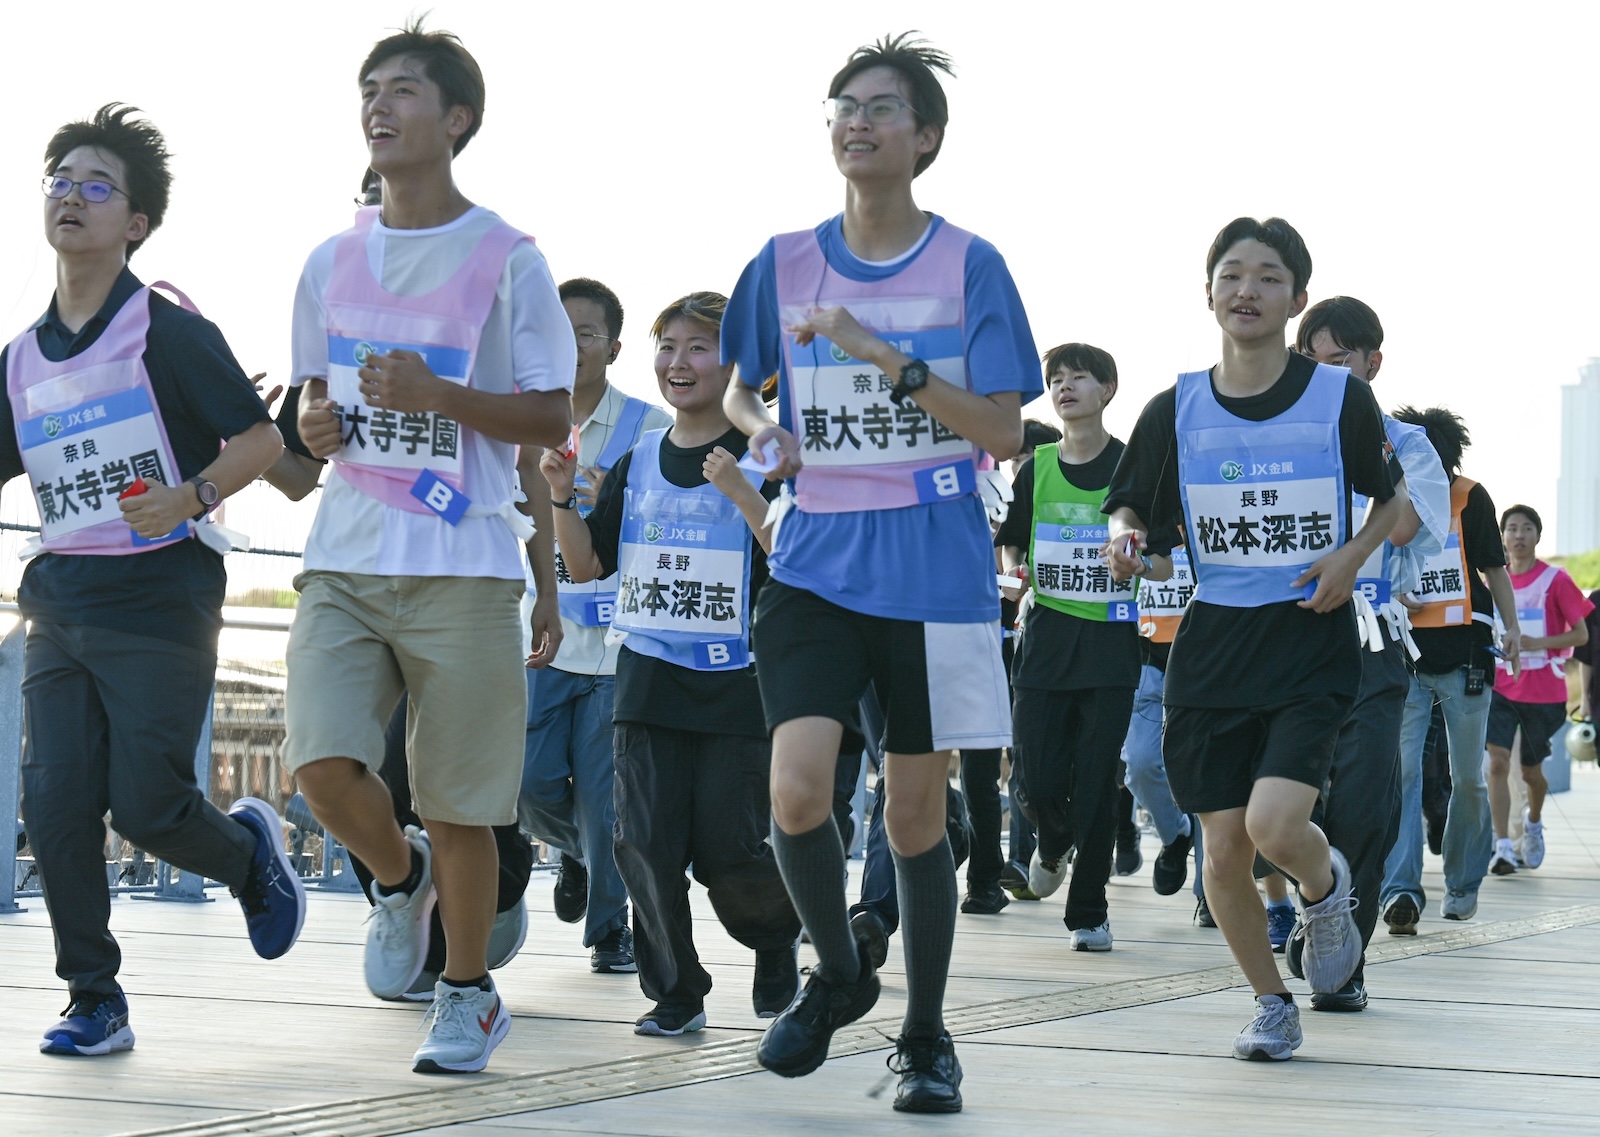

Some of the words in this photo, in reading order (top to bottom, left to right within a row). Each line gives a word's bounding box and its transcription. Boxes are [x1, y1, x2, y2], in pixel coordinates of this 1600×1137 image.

[852, 373, 896, 394] 奈良
[66, 404, 107, 428] JX金属
[62, 437, 100, 464] 奈良
[1248, 461, 1294, 476] JX金属
[932, 466, 961, 497] B
[424, 480, 454, 512] B
[1240, 489, 1279, 508] 長野
[667, 527, 707, 542] JX金属
[1196, 511, 1334, 555] 松本深志
[656, 552, 690, 572] 長野
[1072, 547, 1100, 560] 長野
[1360, 583, 1378, 601] B
[1412, 568, 1462, 596] 武蔵
[620, 573, 737, 622] 松本深志
[597, 603, 615, 623] B
[1116, 604, 1130, 621] B
[707, 643, 731, 665] B
